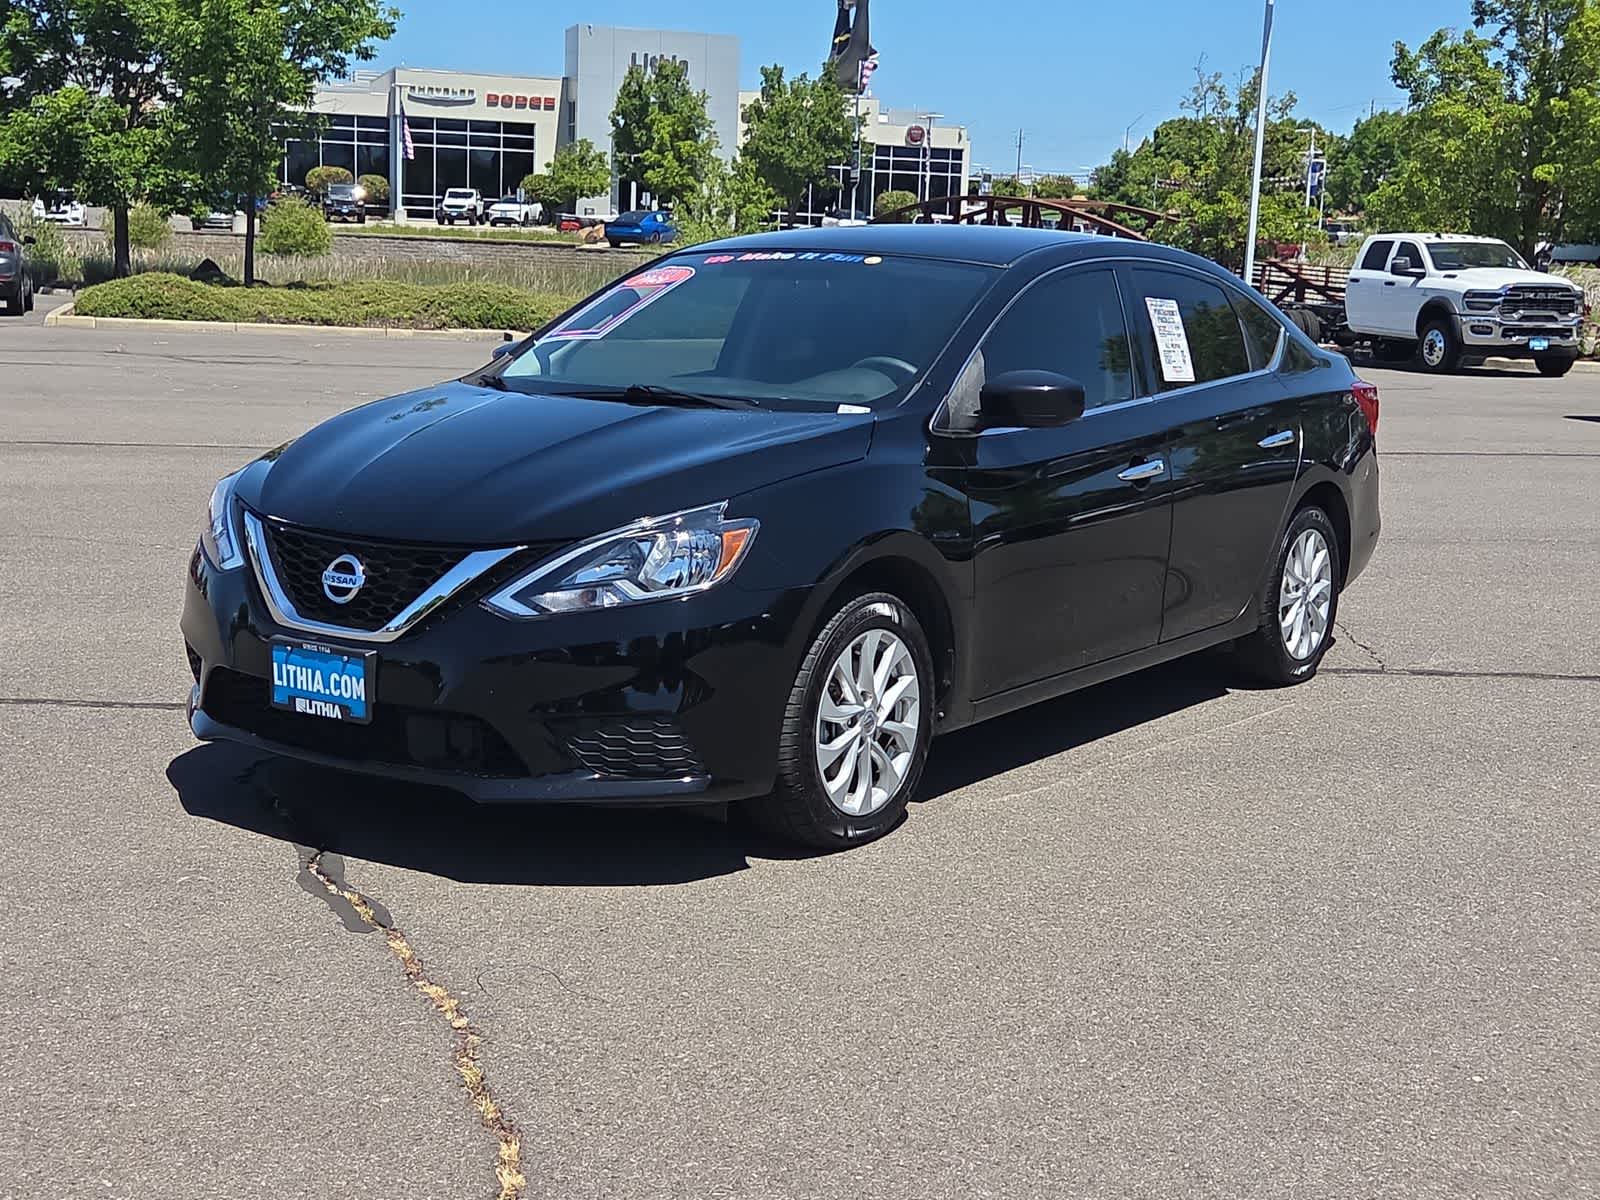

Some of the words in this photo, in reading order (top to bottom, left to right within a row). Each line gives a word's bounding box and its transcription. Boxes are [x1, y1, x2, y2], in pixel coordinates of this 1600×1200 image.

[486, 93, 556, 111] DODGE
[737, 252, 795, 261] Make
[821, 253, 864, 263] Fun
[324, 573, 357, 586] NISSAN
[273, 662, 365, 701] LITHIA.COM
[306, 699, 342, 719] LITHIA
